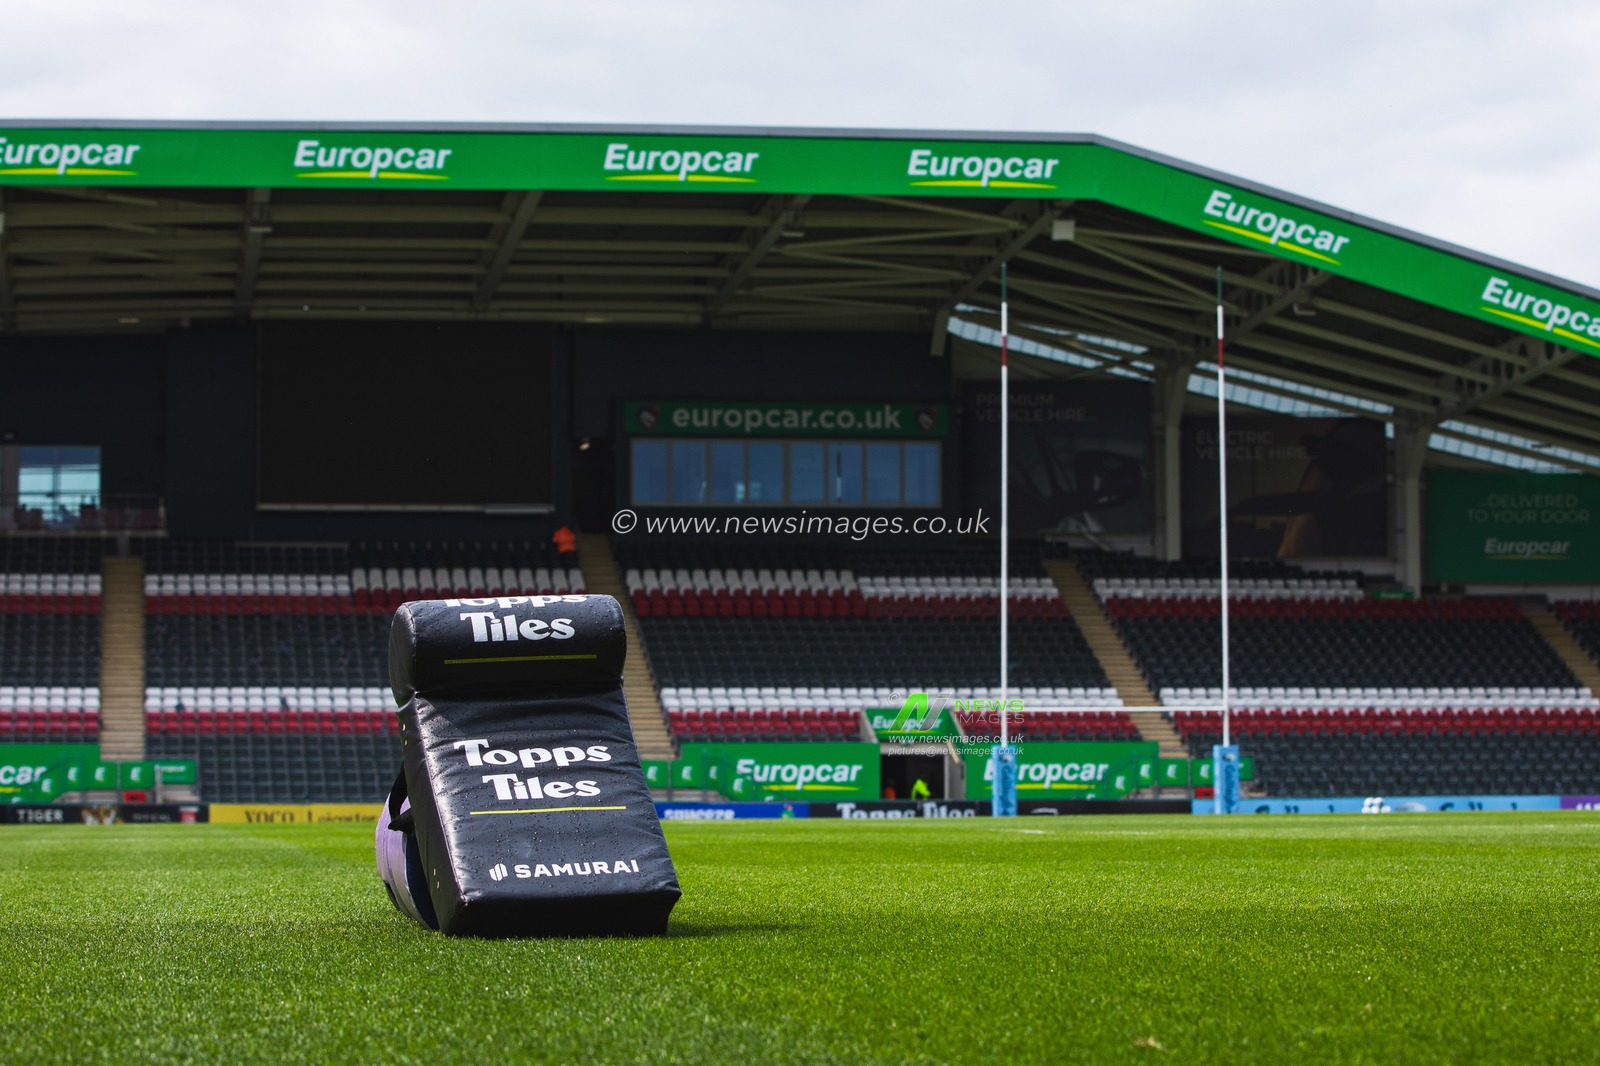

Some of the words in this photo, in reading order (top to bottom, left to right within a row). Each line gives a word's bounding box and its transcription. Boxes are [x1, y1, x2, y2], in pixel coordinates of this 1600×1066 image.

[0, 137, 140, 175] uropcar
[294, 140, 452, 178] Europcar
[604, 143, 759, 182] Europcar
[907, 149, 1060, 188] Europcar
[1203, 190, 1349, 254] Europcar
[976, 393, 1055, 407] PRMIUM
[672, 404, 902, 432] europcar.co.uk
[1195, 430, 1273, 444] ELCTRIC
[1195, 446, 1264, 460] VEICLE
[1466, 509, 1489, 523] TO
[1492, 509, 1537, 523] YOUR
[1541, 509, 1590, 523] DOOR
[1485, 537, 1571, 559] Europcar
[459, 611, 576, 643] Tiles
[872, 715, 943, 734] Eupcr
[454, 739, 612, 768] Topps
[482, 774, 601, 800] Tiles
[736, 759, 863, 790] Europcar
[983, 758, 1109, 790] ropcar
[17, 809, 64, 823] TIGER
[514, 860, 640, 879] SAMURAI
